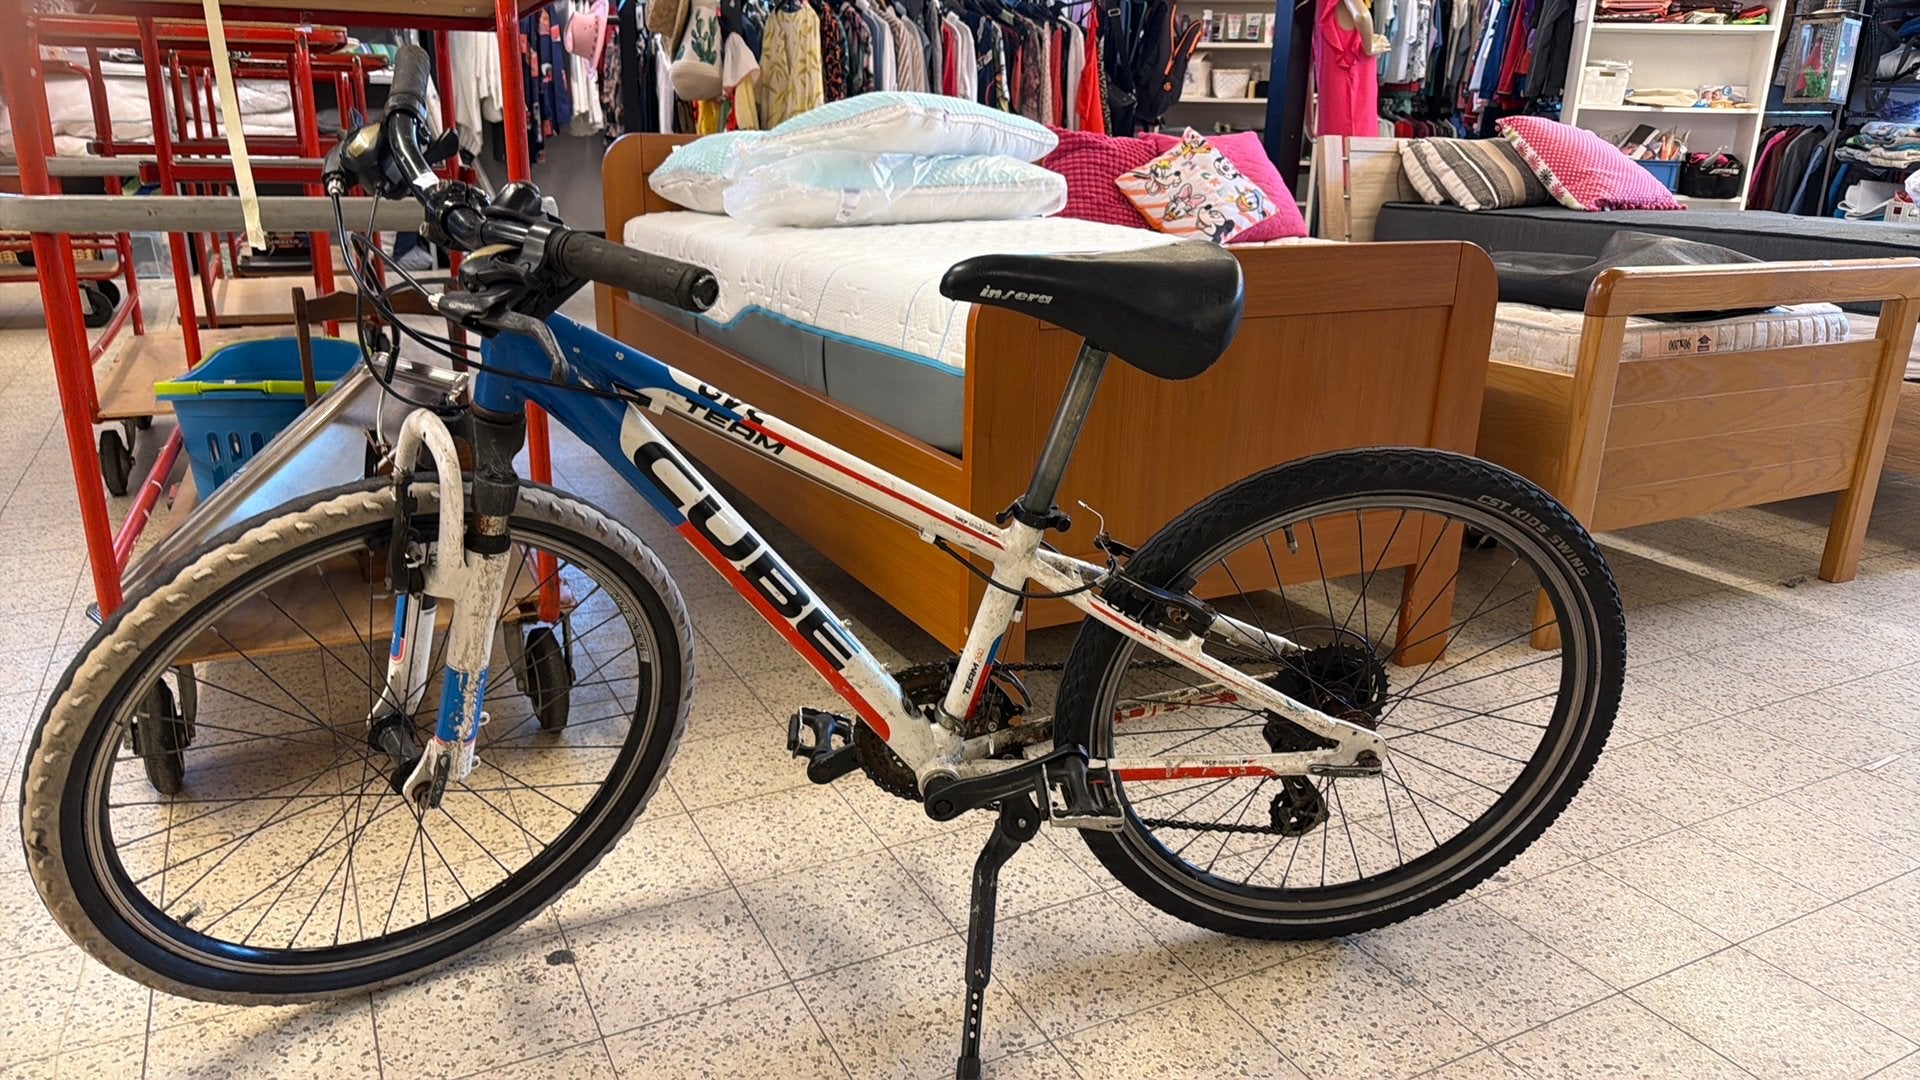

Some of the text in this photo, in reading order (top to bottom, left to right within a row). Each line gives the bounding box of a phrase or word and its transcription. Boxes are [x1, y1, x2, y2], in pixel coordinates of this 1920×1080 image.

[979, 284, 1054, 305] insera
[685, 396, 786, 456] TEAM
[633, 441, 862, 672] CUBE
[1477, 494, 1590, 577] CST KIDS SWING
[962, 662, 980, 695] TEAM
